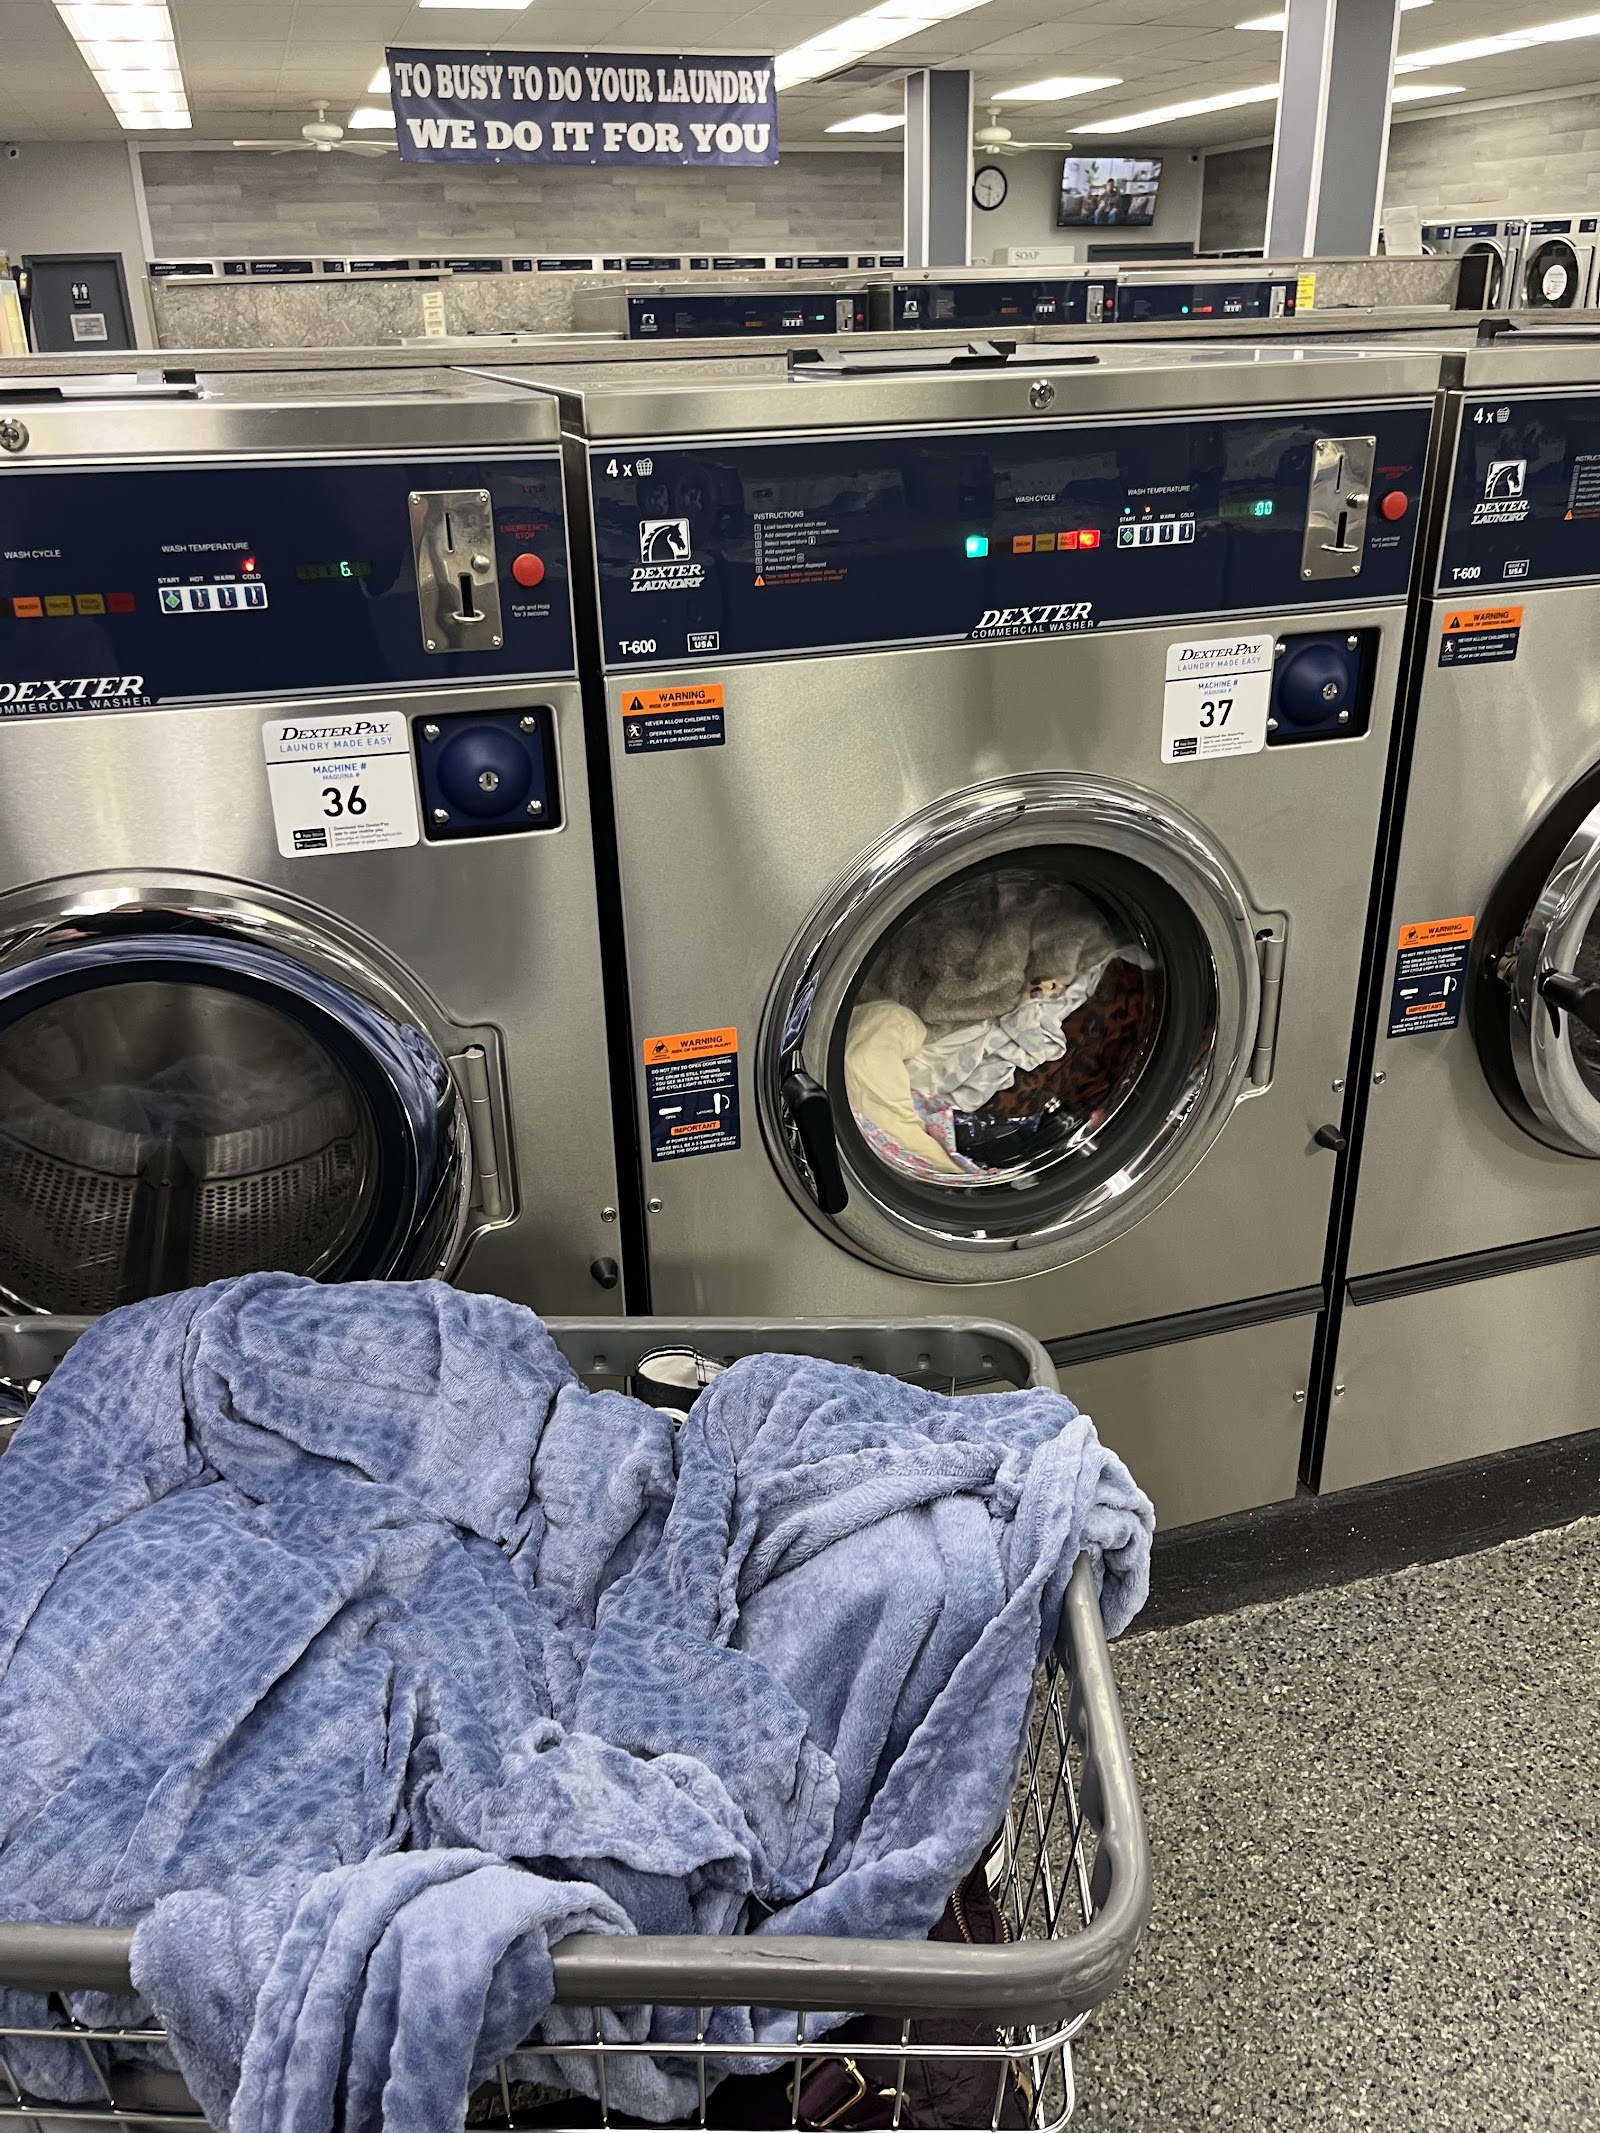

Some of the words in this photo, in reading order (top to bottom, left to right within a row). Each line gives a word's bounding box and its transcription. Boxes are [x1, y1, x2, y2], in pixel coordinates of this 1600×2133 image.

[395, 62, 431, 98] TO
[436, 64, 503, 100] BUSY
[508, 66, 540, 101] TO
[548, 67, 582, 101] DO
[586, 68, 653, 103] YOUR
[657, 69, 770, 103] LAUNDRY
[407, 119, 476, 148] WE
[484, 121, 543, 151] DO
[551, 122, 594, 151] IT
[603, 123, 683, 152] FOR
[689, 124, 770, 153] YOU
[1015, 251, 1040, 260] SOAP
[1474, 407, 1483, 424] 4
[606, 459, 618, 477] 4
[623, 463, 632, 477] x
[1128, 488, 1145, 496] WASH
[1147, 485, 1190, 494] TEMPERATURE
[1035, 494, 1056, 502] CYCLE
[1473, 500, 1527, 514] DEXTER
[754, 511, 804, 520] INSTRUCTIONS
[1471, 511, 1529, 525] LAUNDRY
[188, 542, 249, 552] TEMPERATURE
[4, 550, 30, 559] WASH
[32, 549, 61, 558] CYCLE
[631, 564, 702, 580] DEXTER
[1452, 566, 1481, 580] T-600
[1508, 567, 1523, 575] USA
[631, 577, 704, 592] LAUNDRY
[975, 602, 1092, 629] DEXTER
[1473, 612, 1509, 620] WARNING
[972, 626, 1044, 638] COMMERCIAL
[1050, 620, 1094, 631] WASHER
[619, 639, 656, 655] T-600
[695, 640, 713, 649] USA
[1178, 662, 1214, 671] LAUNDRY
[1198, 680, 1231, 690] MACHINE
[659, 691, 705, 701] WARNING
[90, 696, 151, 708] WASHER
[1200, 699, 1233, 728] 37
[280, 742, 329, 753] LAUNDRY
[334, 740, 363, 748] MADE
[368, 737, 392, 746] EASY
[313, 763, 357, 774] MACHINE
[361, 762, 366, 770] #
[322, 785, 367, 817] 36
[1428, 924, 1462, 934] WARNING
[1408, 1003, 1443, 1013] IMPORTANT
[680, 1036, 723, 1047] WARNING
[674, 1122, 716, 1133] IMPORTANT
[694, 1132, 725, 1140] INTERRUPTED
